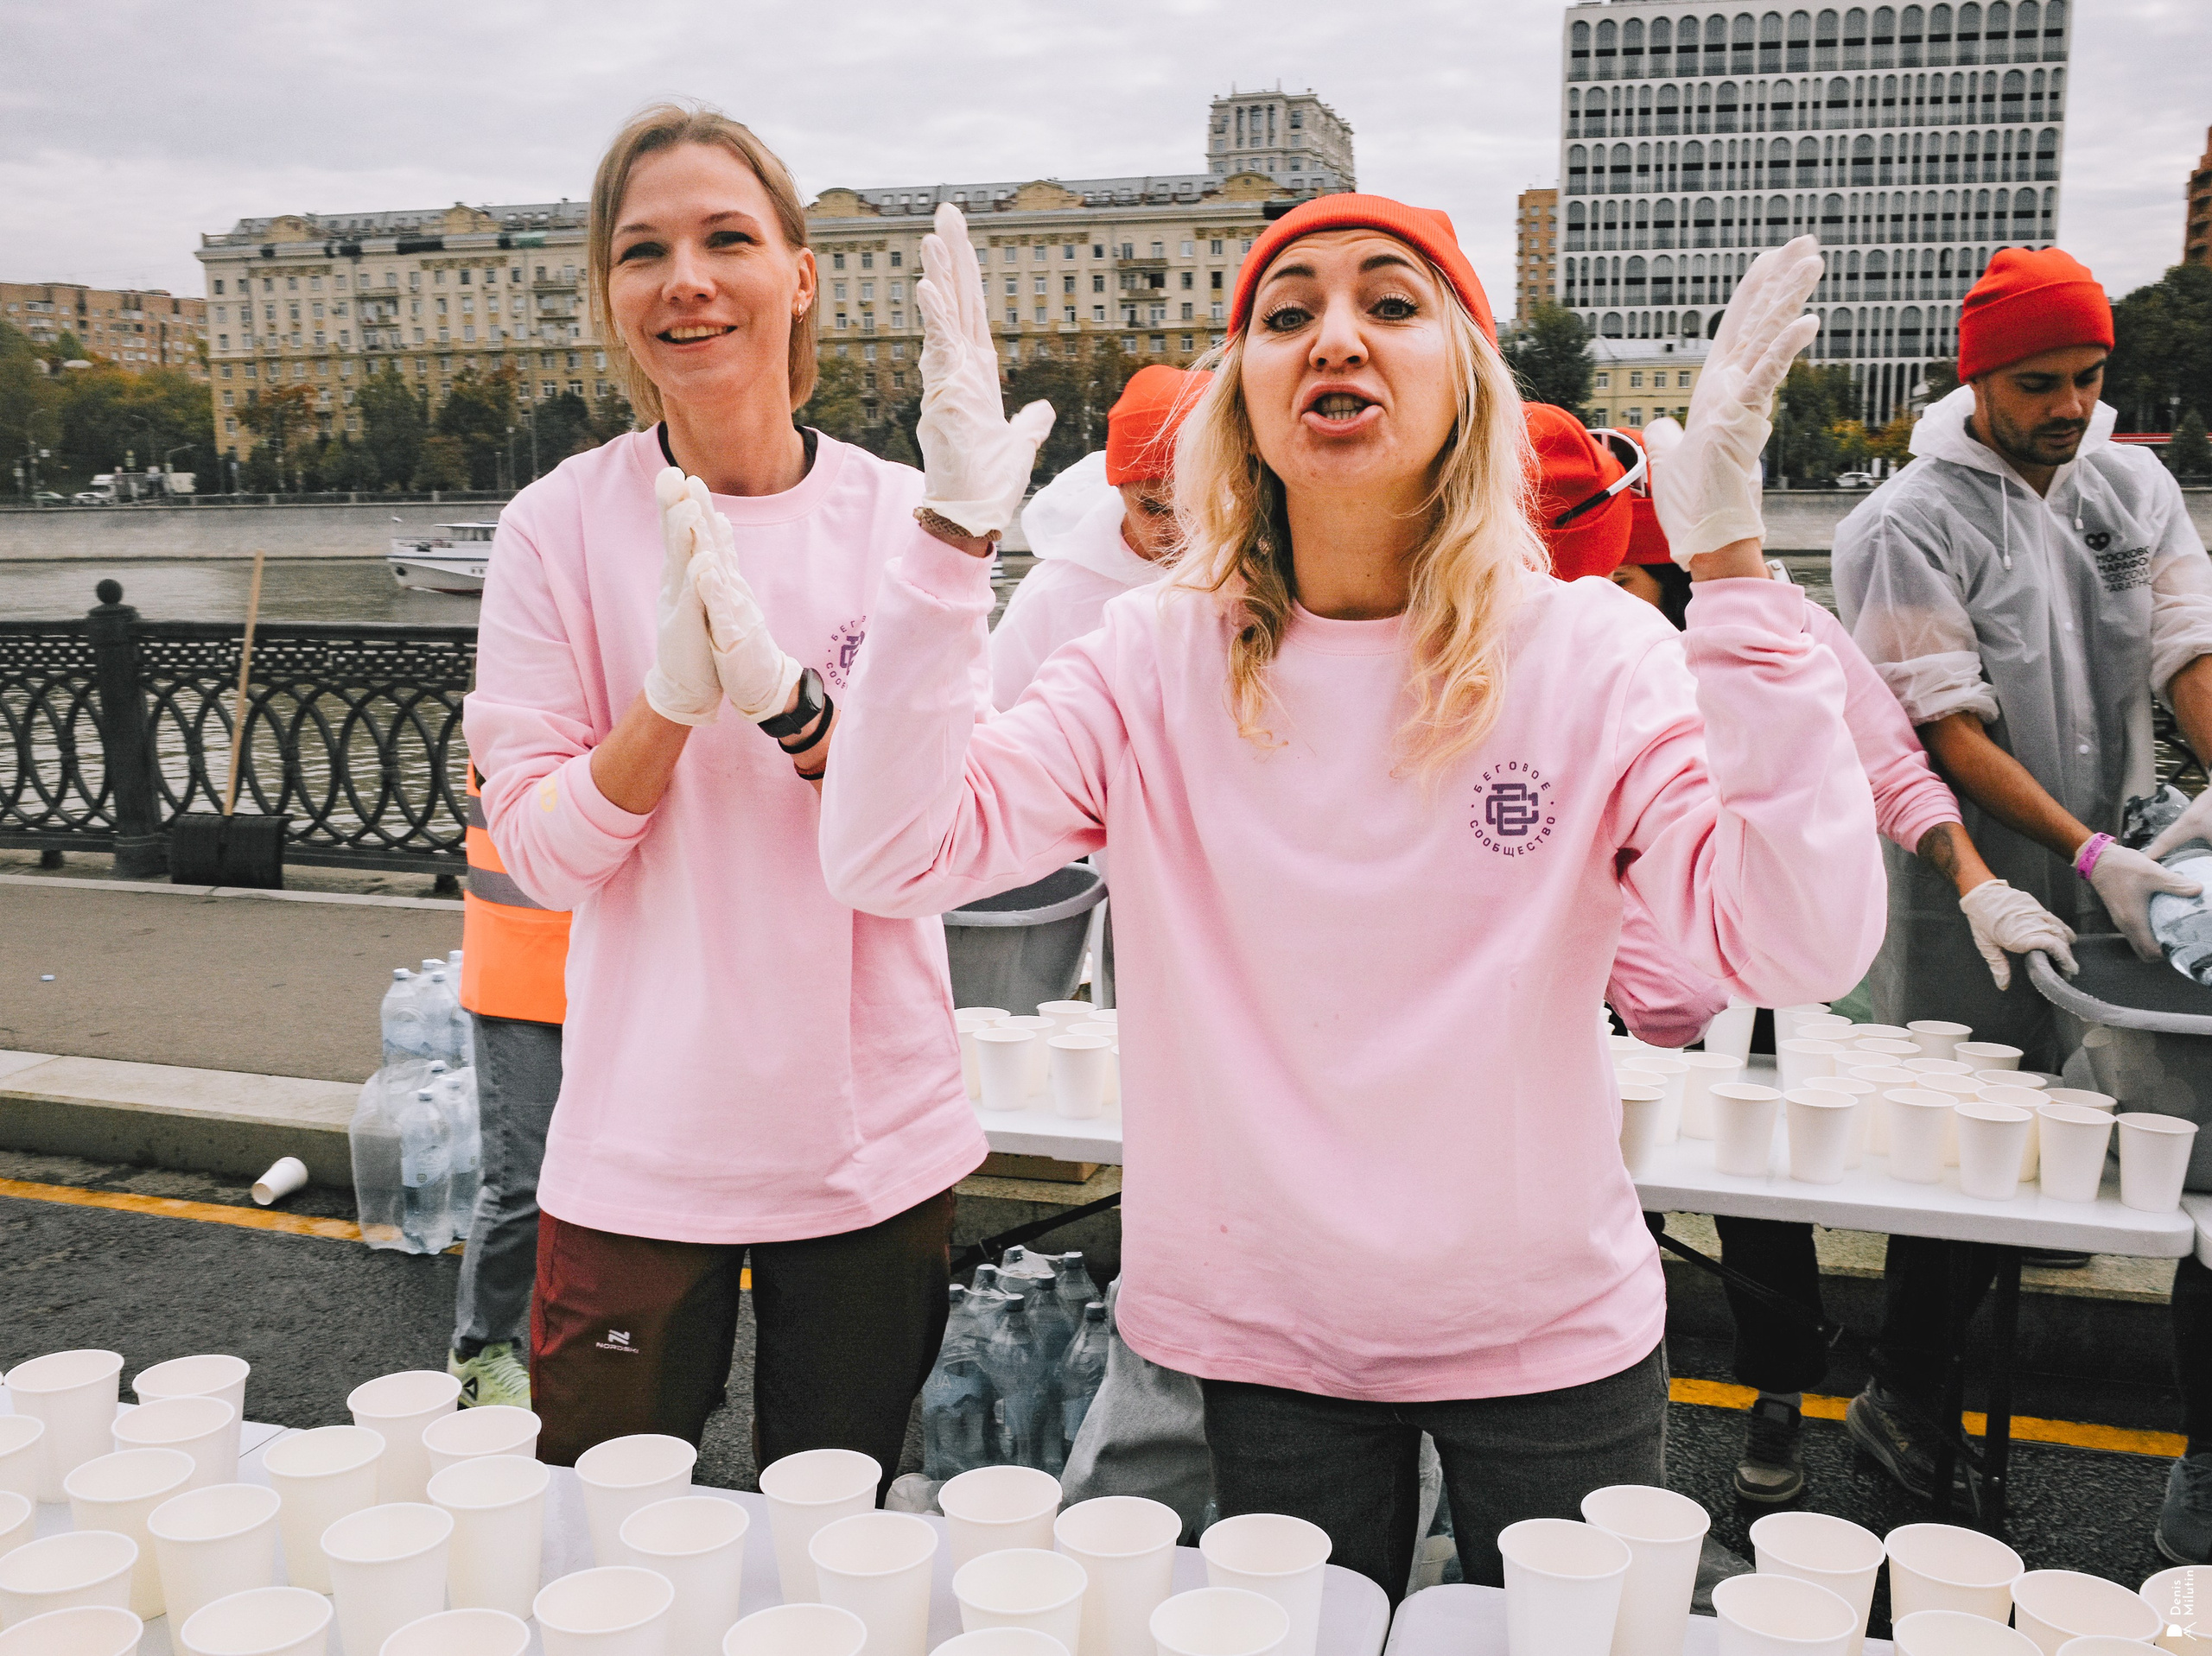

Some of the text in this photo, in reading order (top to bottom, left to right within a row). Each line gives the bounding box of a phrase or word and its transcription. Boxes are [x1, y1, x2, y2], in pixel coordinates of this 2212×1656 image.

[1473, 761, 1551, 794] БЕГОВОЕ
[1470, 816, 1555, 858] СООБЩЕСТВО
[595, 1342, 639, 1355] NORDSKI
